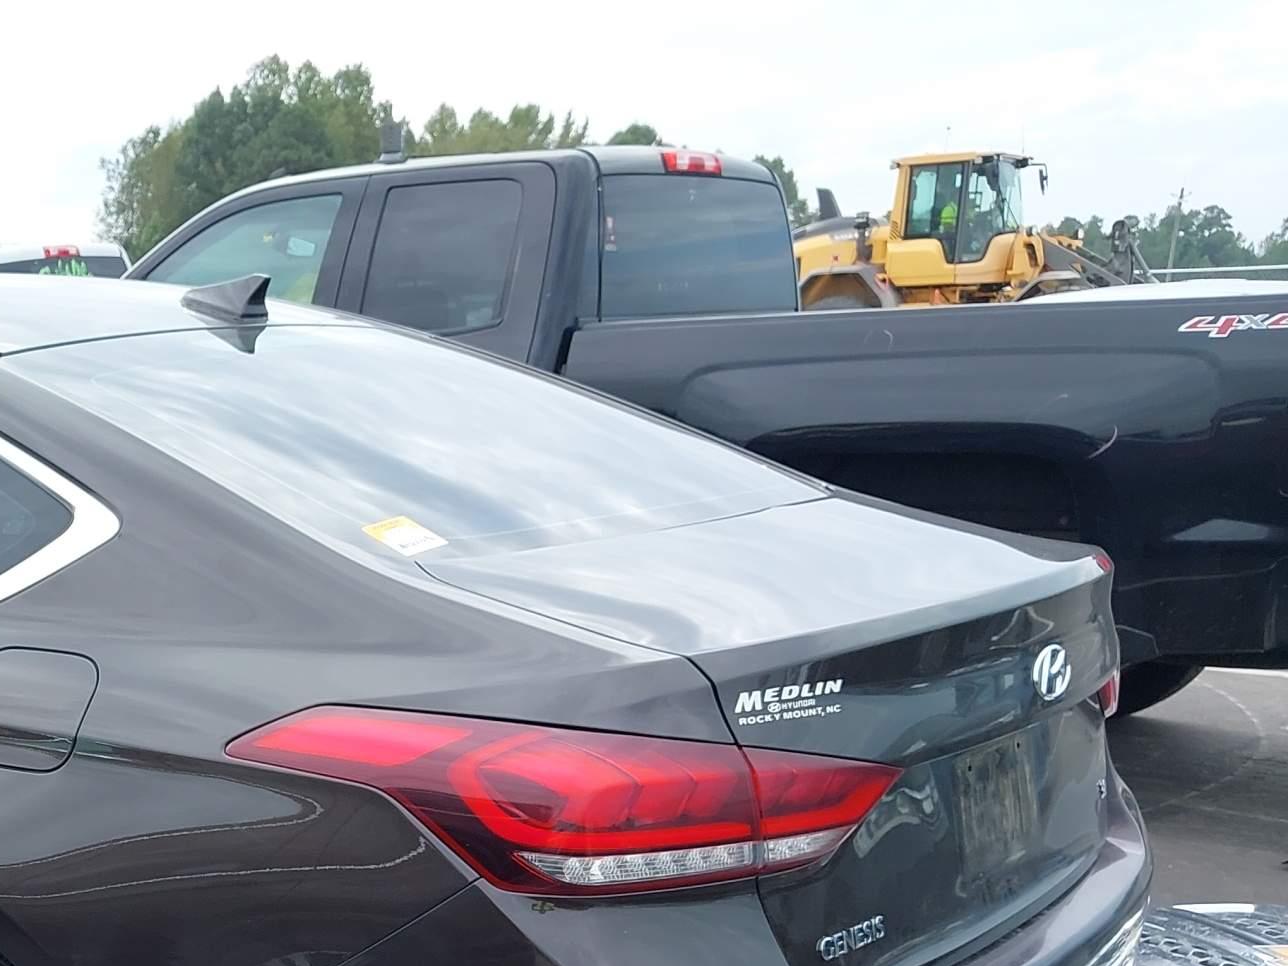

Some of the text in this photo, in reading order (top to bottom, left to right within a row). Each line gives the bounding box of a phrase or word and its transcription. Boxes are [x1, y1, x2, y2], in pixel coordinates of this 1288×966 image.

[734, 679, 843, 713] MEDLIN
[780, 698, 817, 710] HYUNDAI
[738, 704, 842, 726] ROCKY MOUNT, NC
[816, 915, 886, 961] GENESIS
